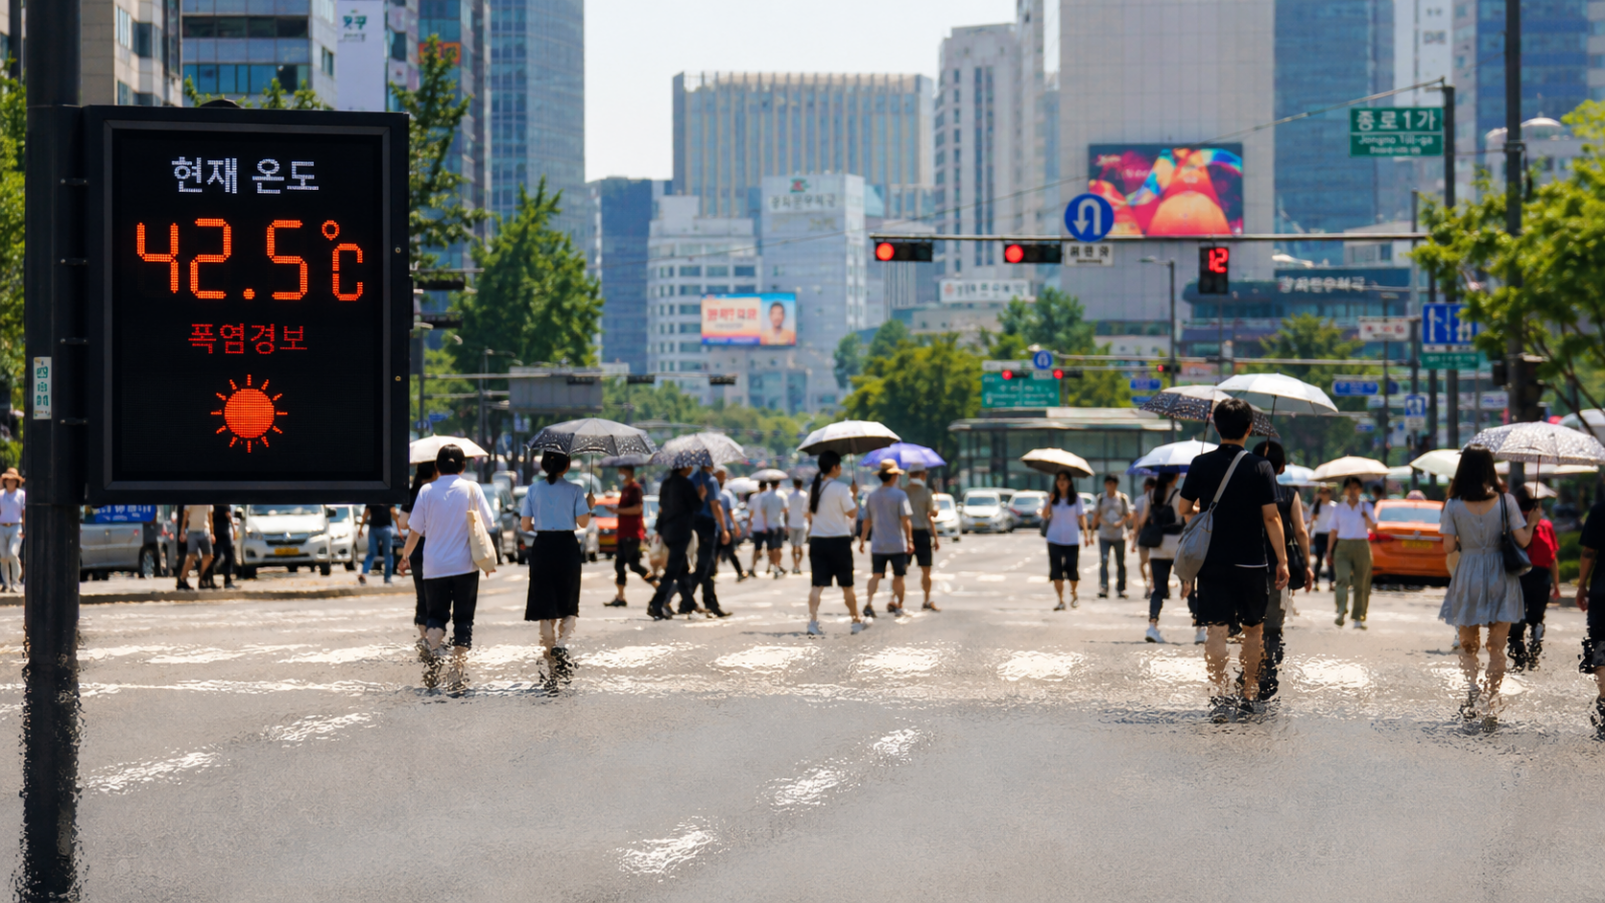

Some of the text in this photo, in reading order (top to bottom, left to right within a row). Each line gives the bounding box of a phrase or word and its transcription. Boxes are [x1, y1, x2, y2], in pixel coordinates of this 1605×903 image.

[1356, 110, 1436, 131] 종로1가
[171, 156, 320, 194] 현재 온도
[1208, 247, 1229, 274] 12
[188, 323, 308, 354] 폭염경보
